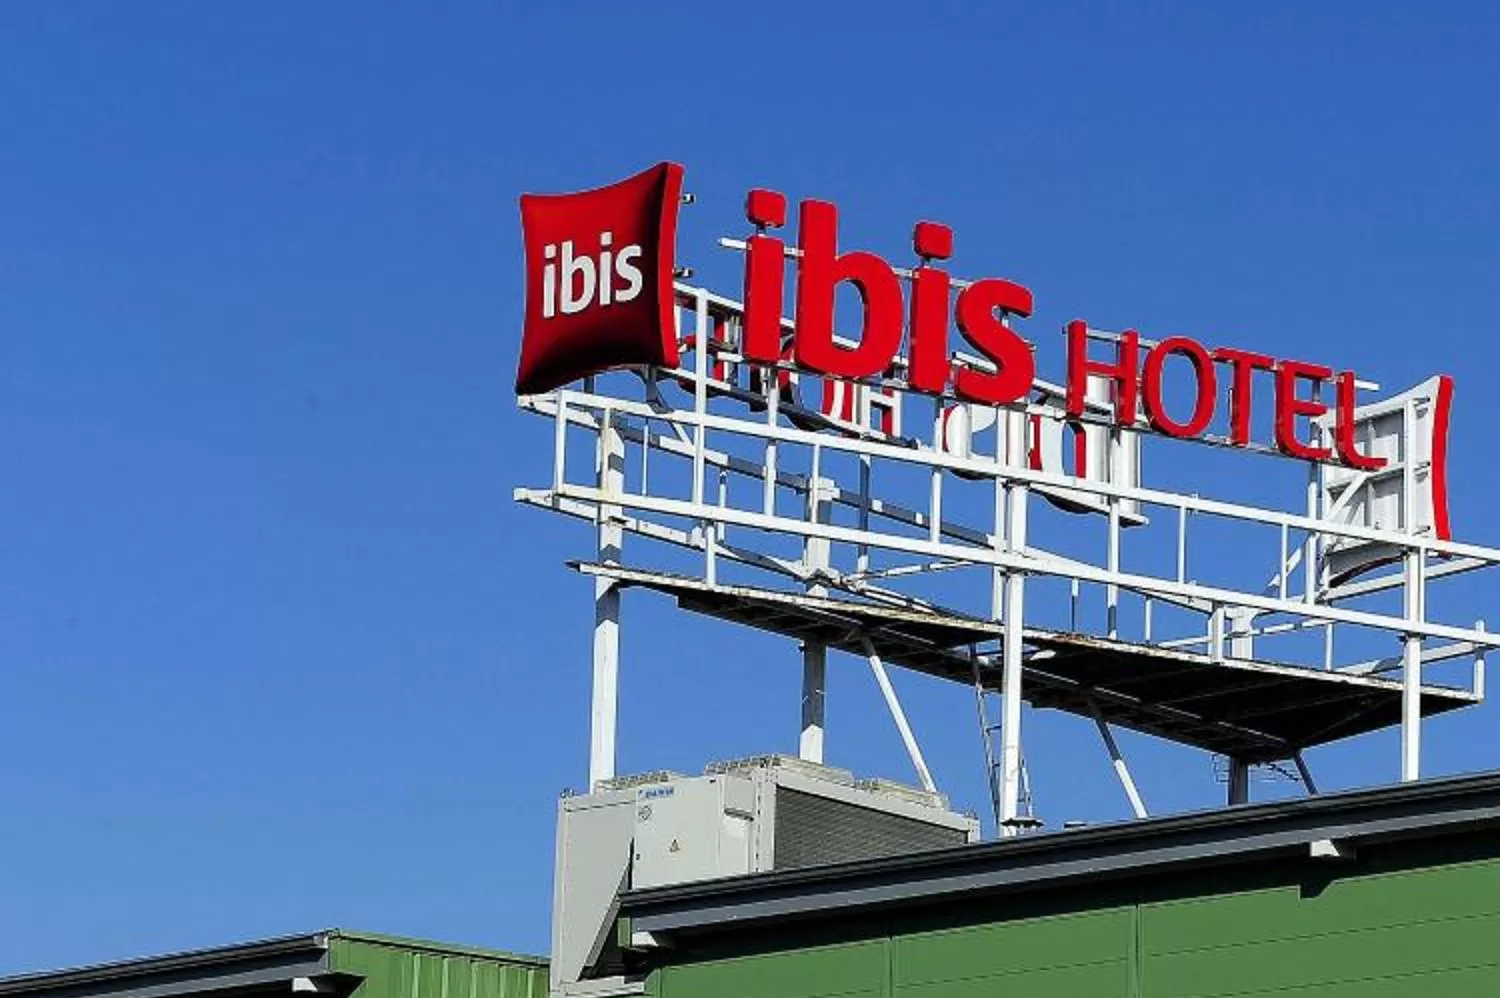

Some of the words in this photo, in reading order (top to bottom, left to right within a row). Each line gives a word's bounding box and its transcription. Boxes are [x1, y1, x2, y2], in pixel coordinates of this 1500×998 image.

[543, 231, 644, 319] ibis
[742, 188, 1035, 406] ibis
[1065, 319, 1389, 470] HOTEL
